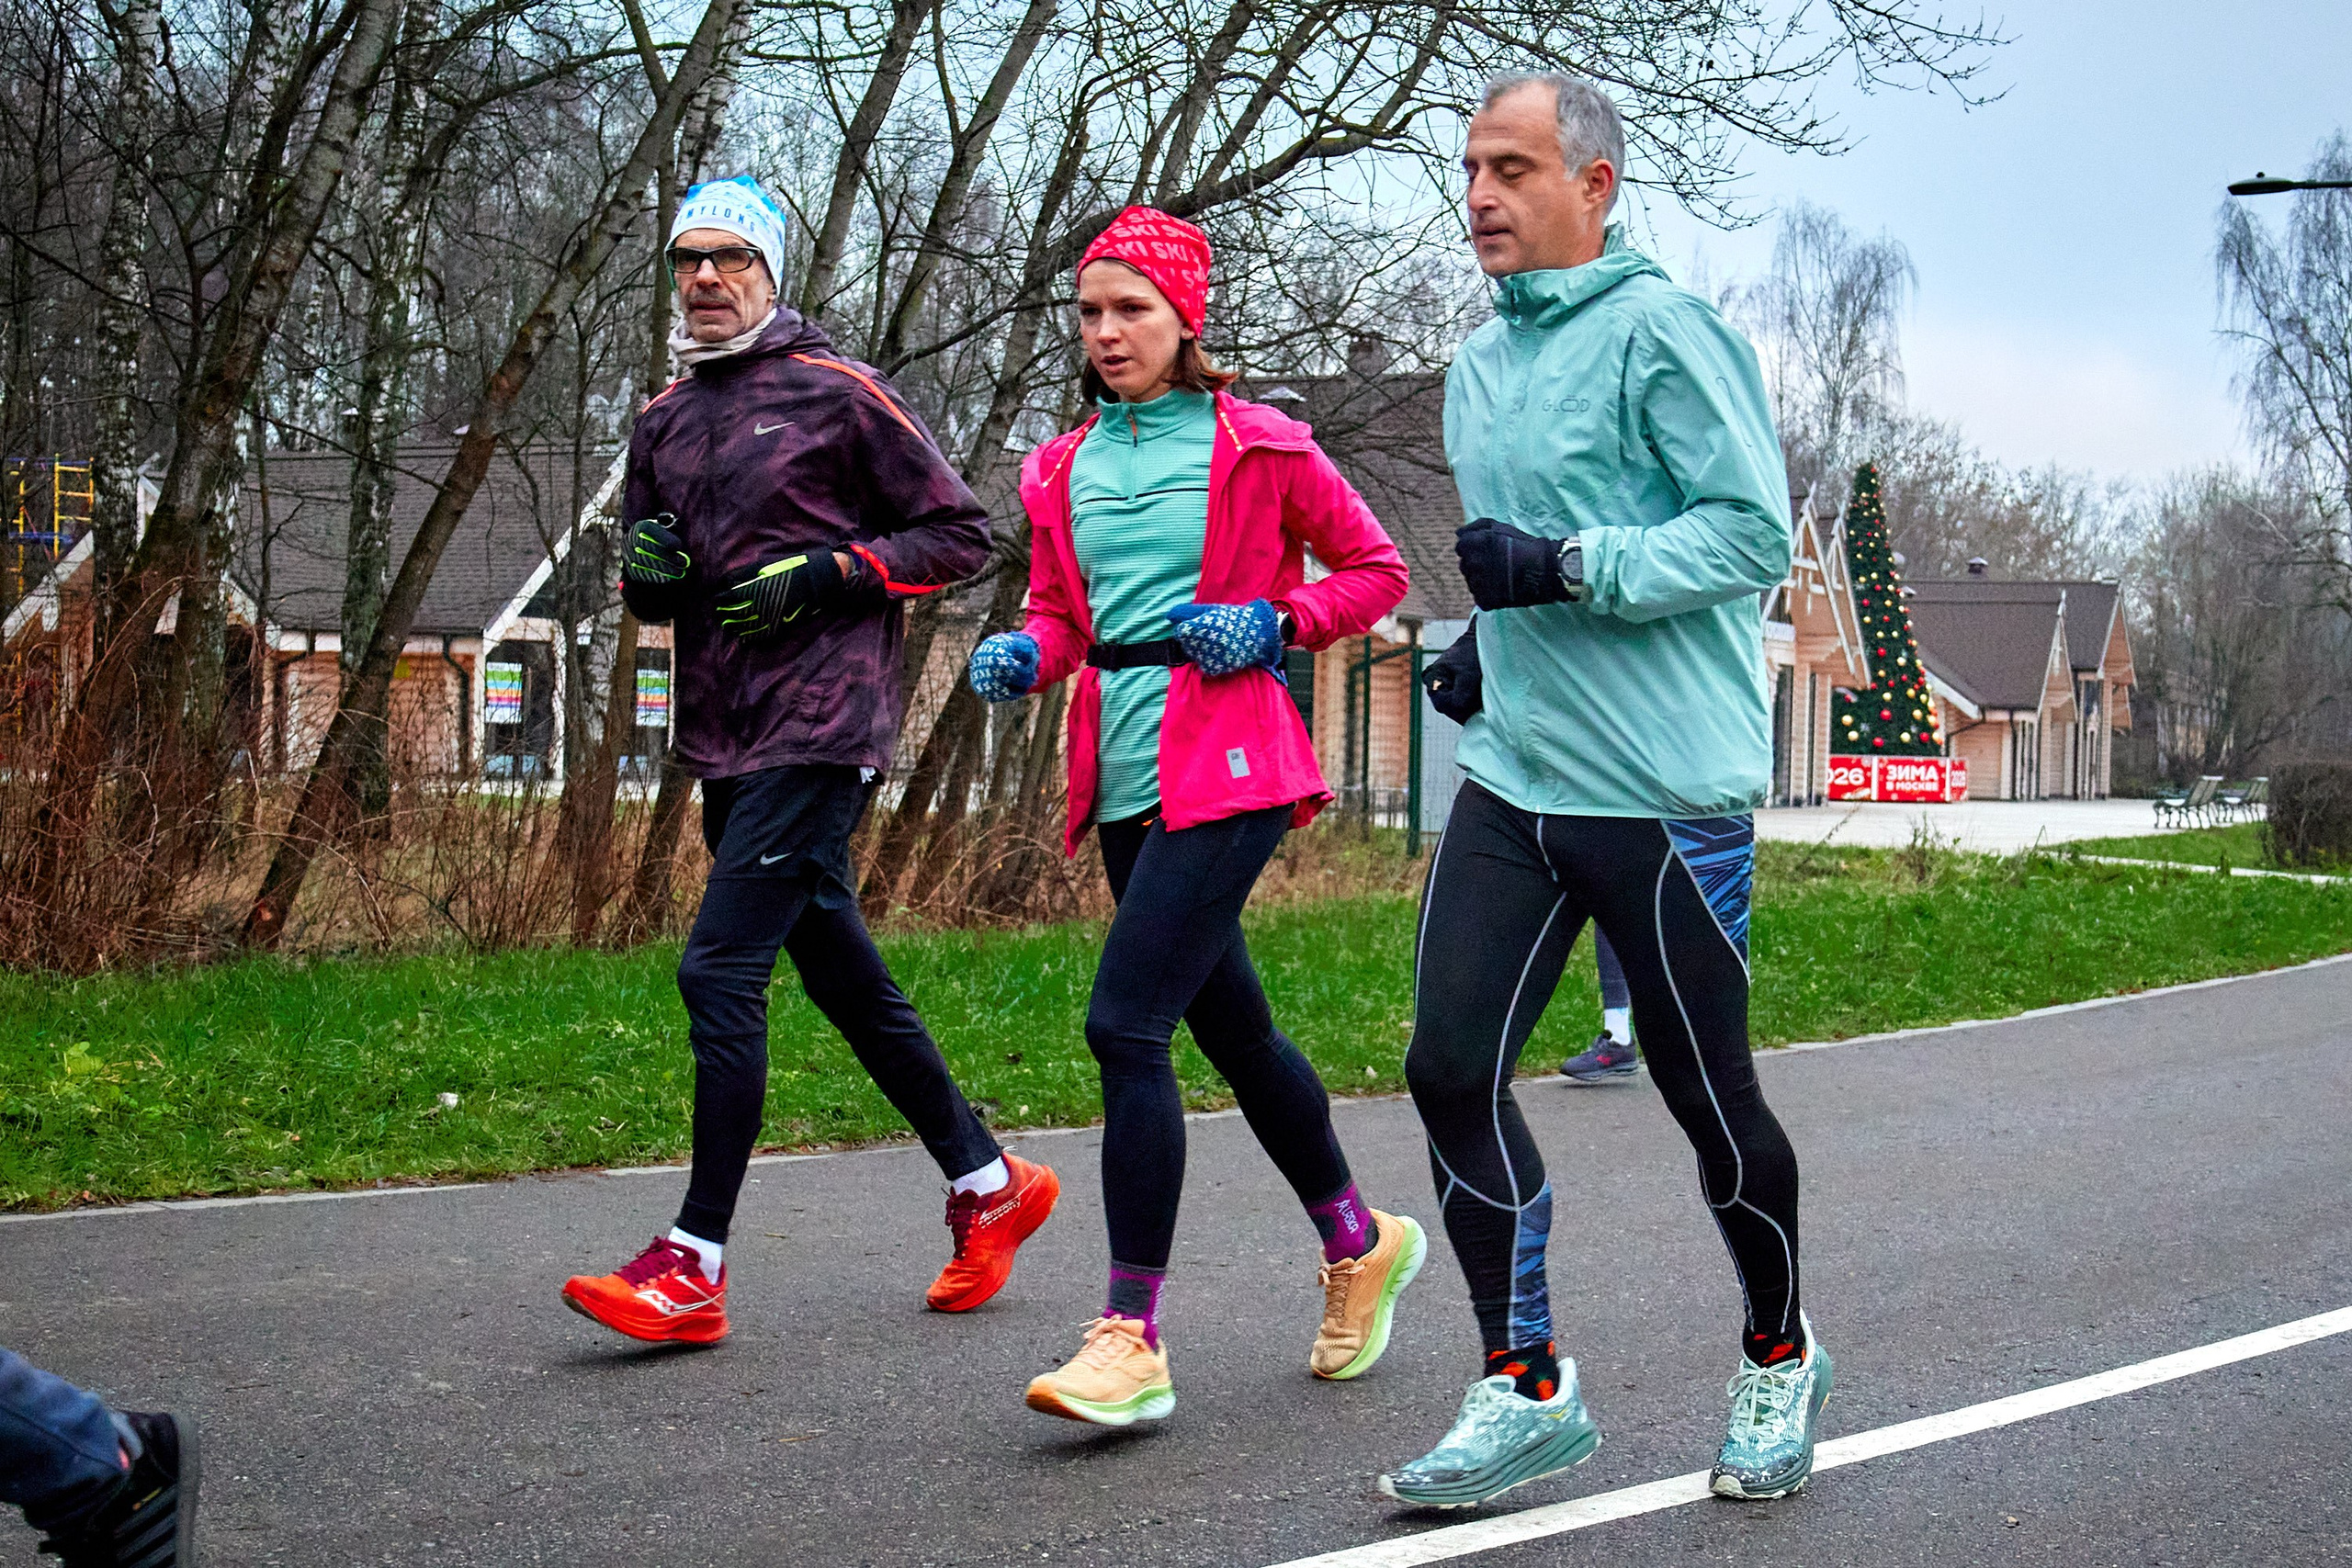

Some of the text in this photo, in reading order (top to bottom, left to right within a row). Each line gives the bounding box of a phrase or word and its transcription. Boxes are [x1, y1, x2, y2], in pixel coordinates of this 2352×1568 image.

[1112, 224, 1159, 237] SKI
[1150, 242, 1188, 262] SKI
[1886, 764, 1939, 781] ЗИМА
